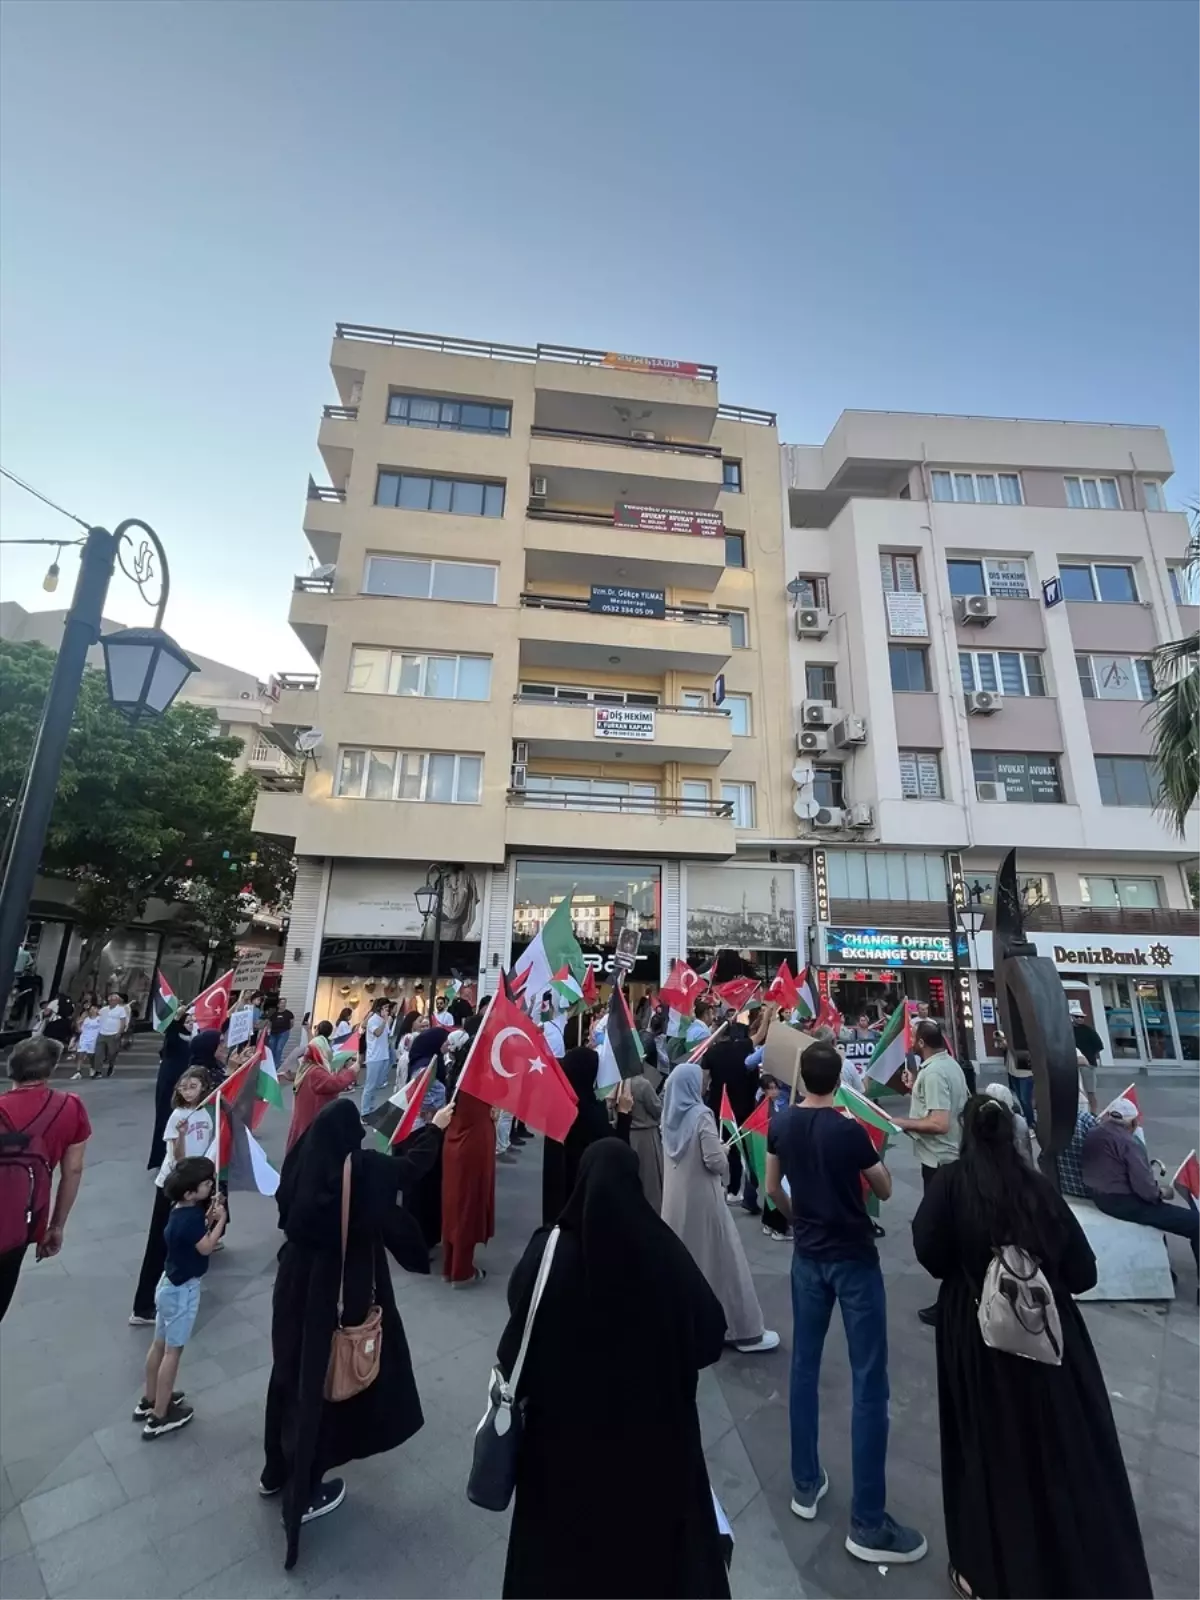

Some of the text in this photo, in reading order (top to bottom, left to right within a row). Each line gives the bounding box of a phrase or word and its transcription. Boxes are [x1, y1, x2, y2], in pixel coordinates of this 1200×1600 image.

[641, 512, 666, 520] AVUKAT
[696, 517, 721, 525] AVUKAT
[610, 710, 652, 721] DİŞ HEKİMİ
[998, 764, 1025, 774] AVUKAT
[1029, 766, 1056, 775] AVUKAT
[816, 855, 828, 920] CHANGE
[843, 933, 951, 949] CHANGE OFFICE
[842, 948, 954, 962] EXCHANGE OFFICE
[1053, 945, 1148, 966] DenizBank
